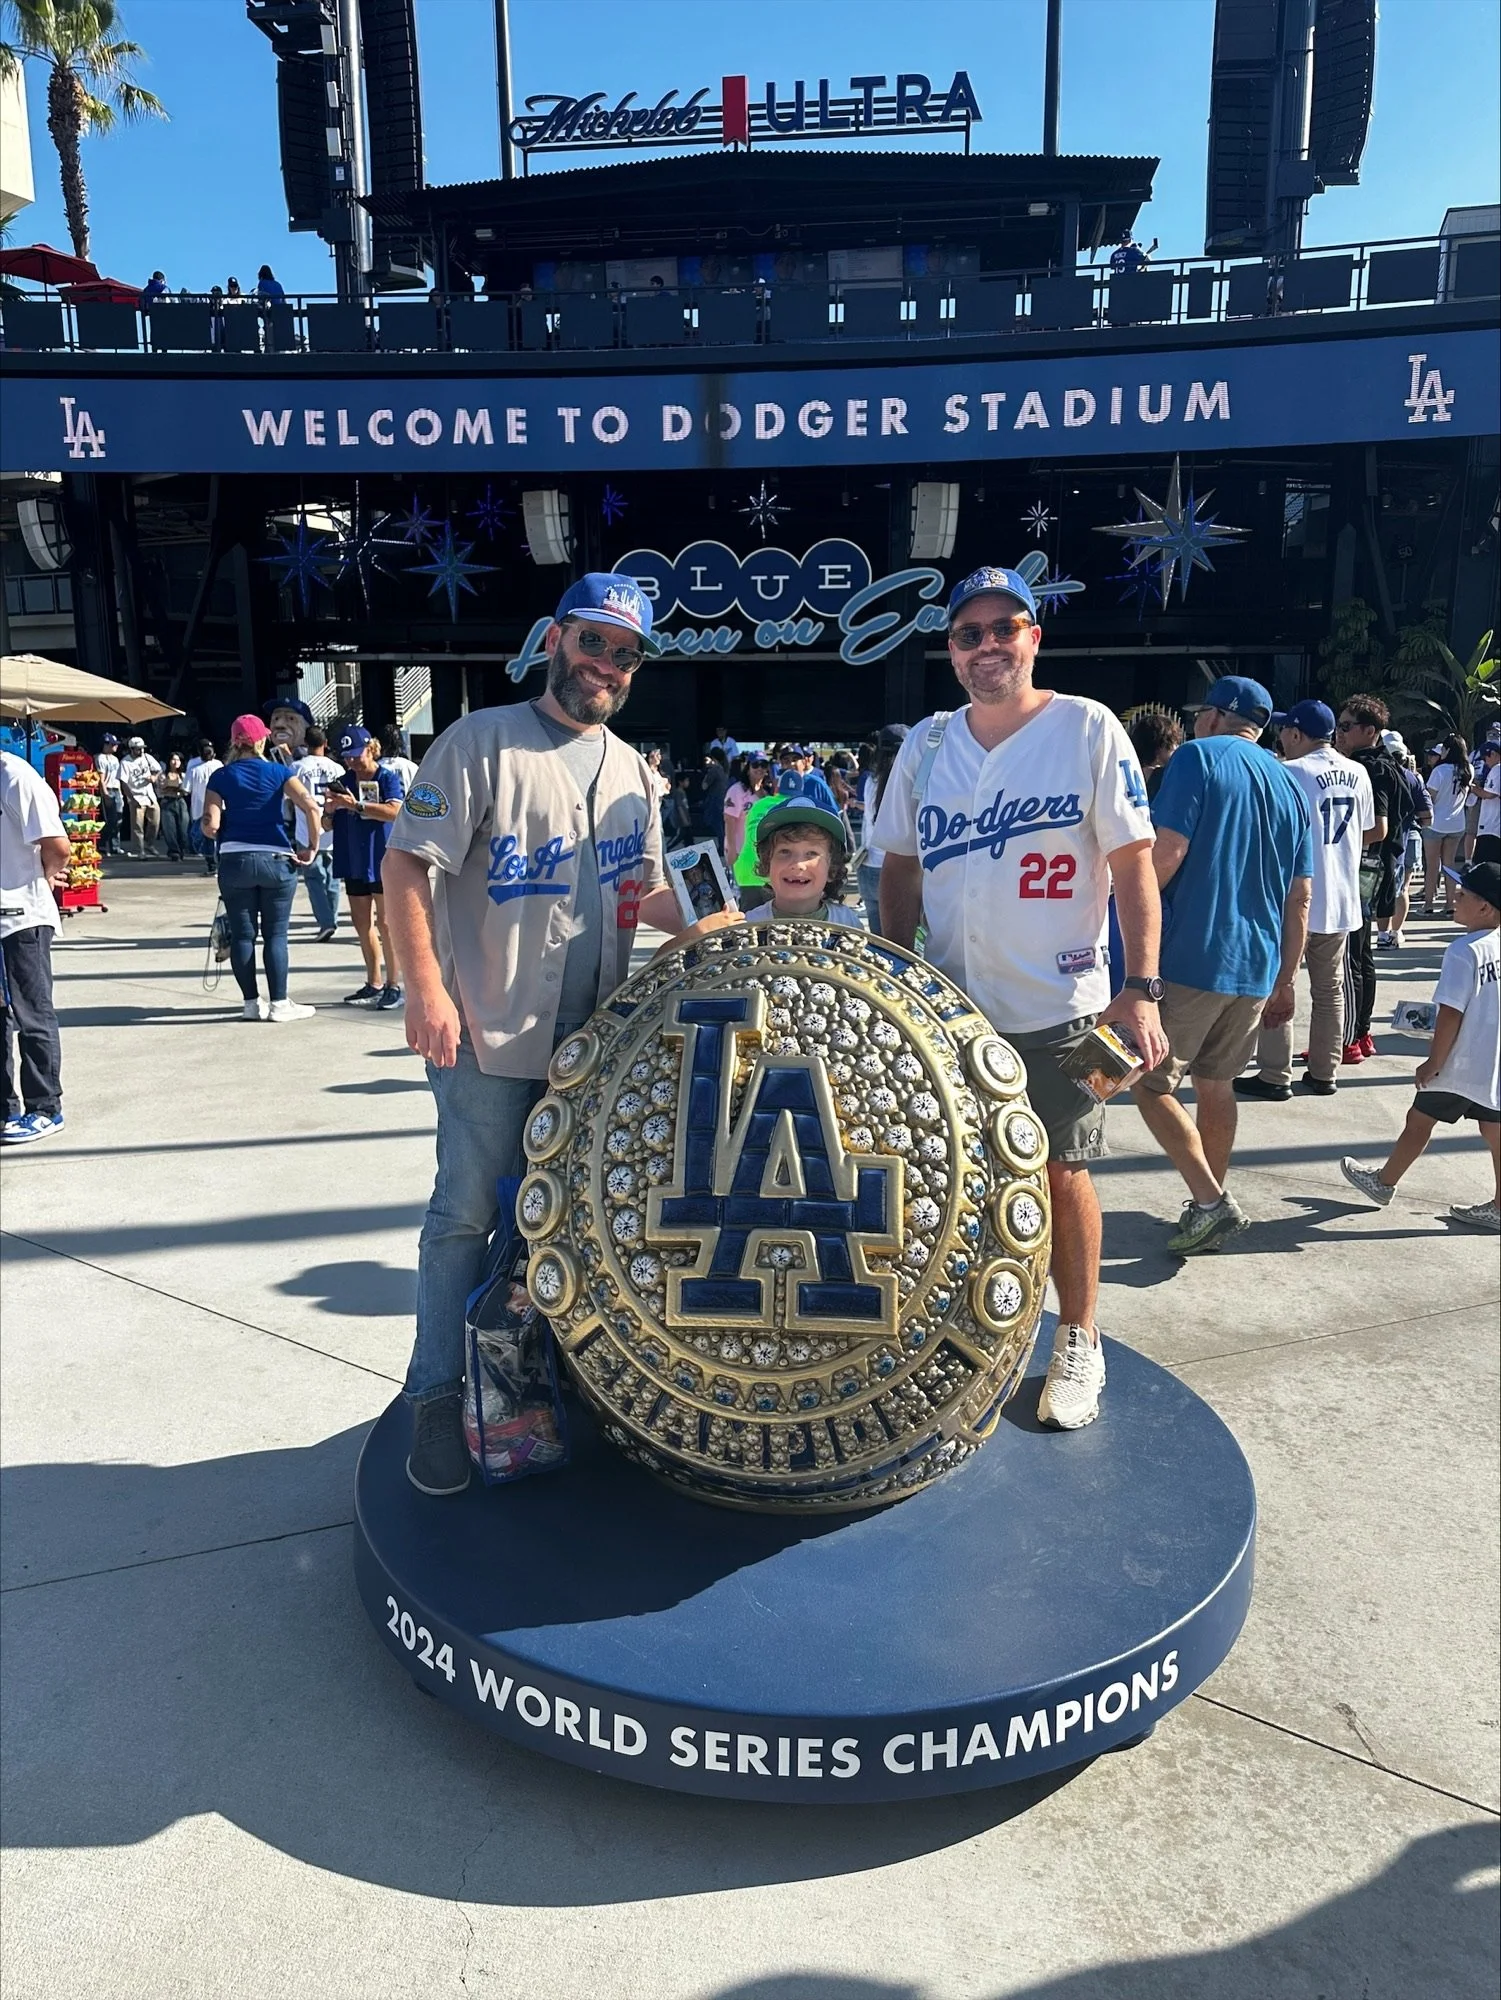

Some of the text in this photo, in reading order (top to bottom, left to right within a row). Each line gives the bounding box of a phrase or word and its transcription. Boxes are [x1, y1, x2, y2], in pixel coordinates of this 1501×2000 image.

[509, 70, 983, 149] Michelob ULTRA
[242, 381, 1231, 446] WELCOME TO DODGER STADIUM
[1404, 354, 1454, 423] LA
[60, 398, 106, 459] LA
[633, 564, 852, 601] BLUE
[755, 616, 825, 648] on
[1119, 760, 1149, 807] LA
[1316, 770, 1358, 790] OHTANI
[918, 788, 1083, 860] Dodgers
[1319, 796, 1354, 845] 17
[488, 834, 530, 881] Los
[1019, 853, 1076, 899] 22
[646, 990, 904, 1336] LA
[386, 1595, 1179, 1778] 2024 WORLD SERIES CHAMPIONS
